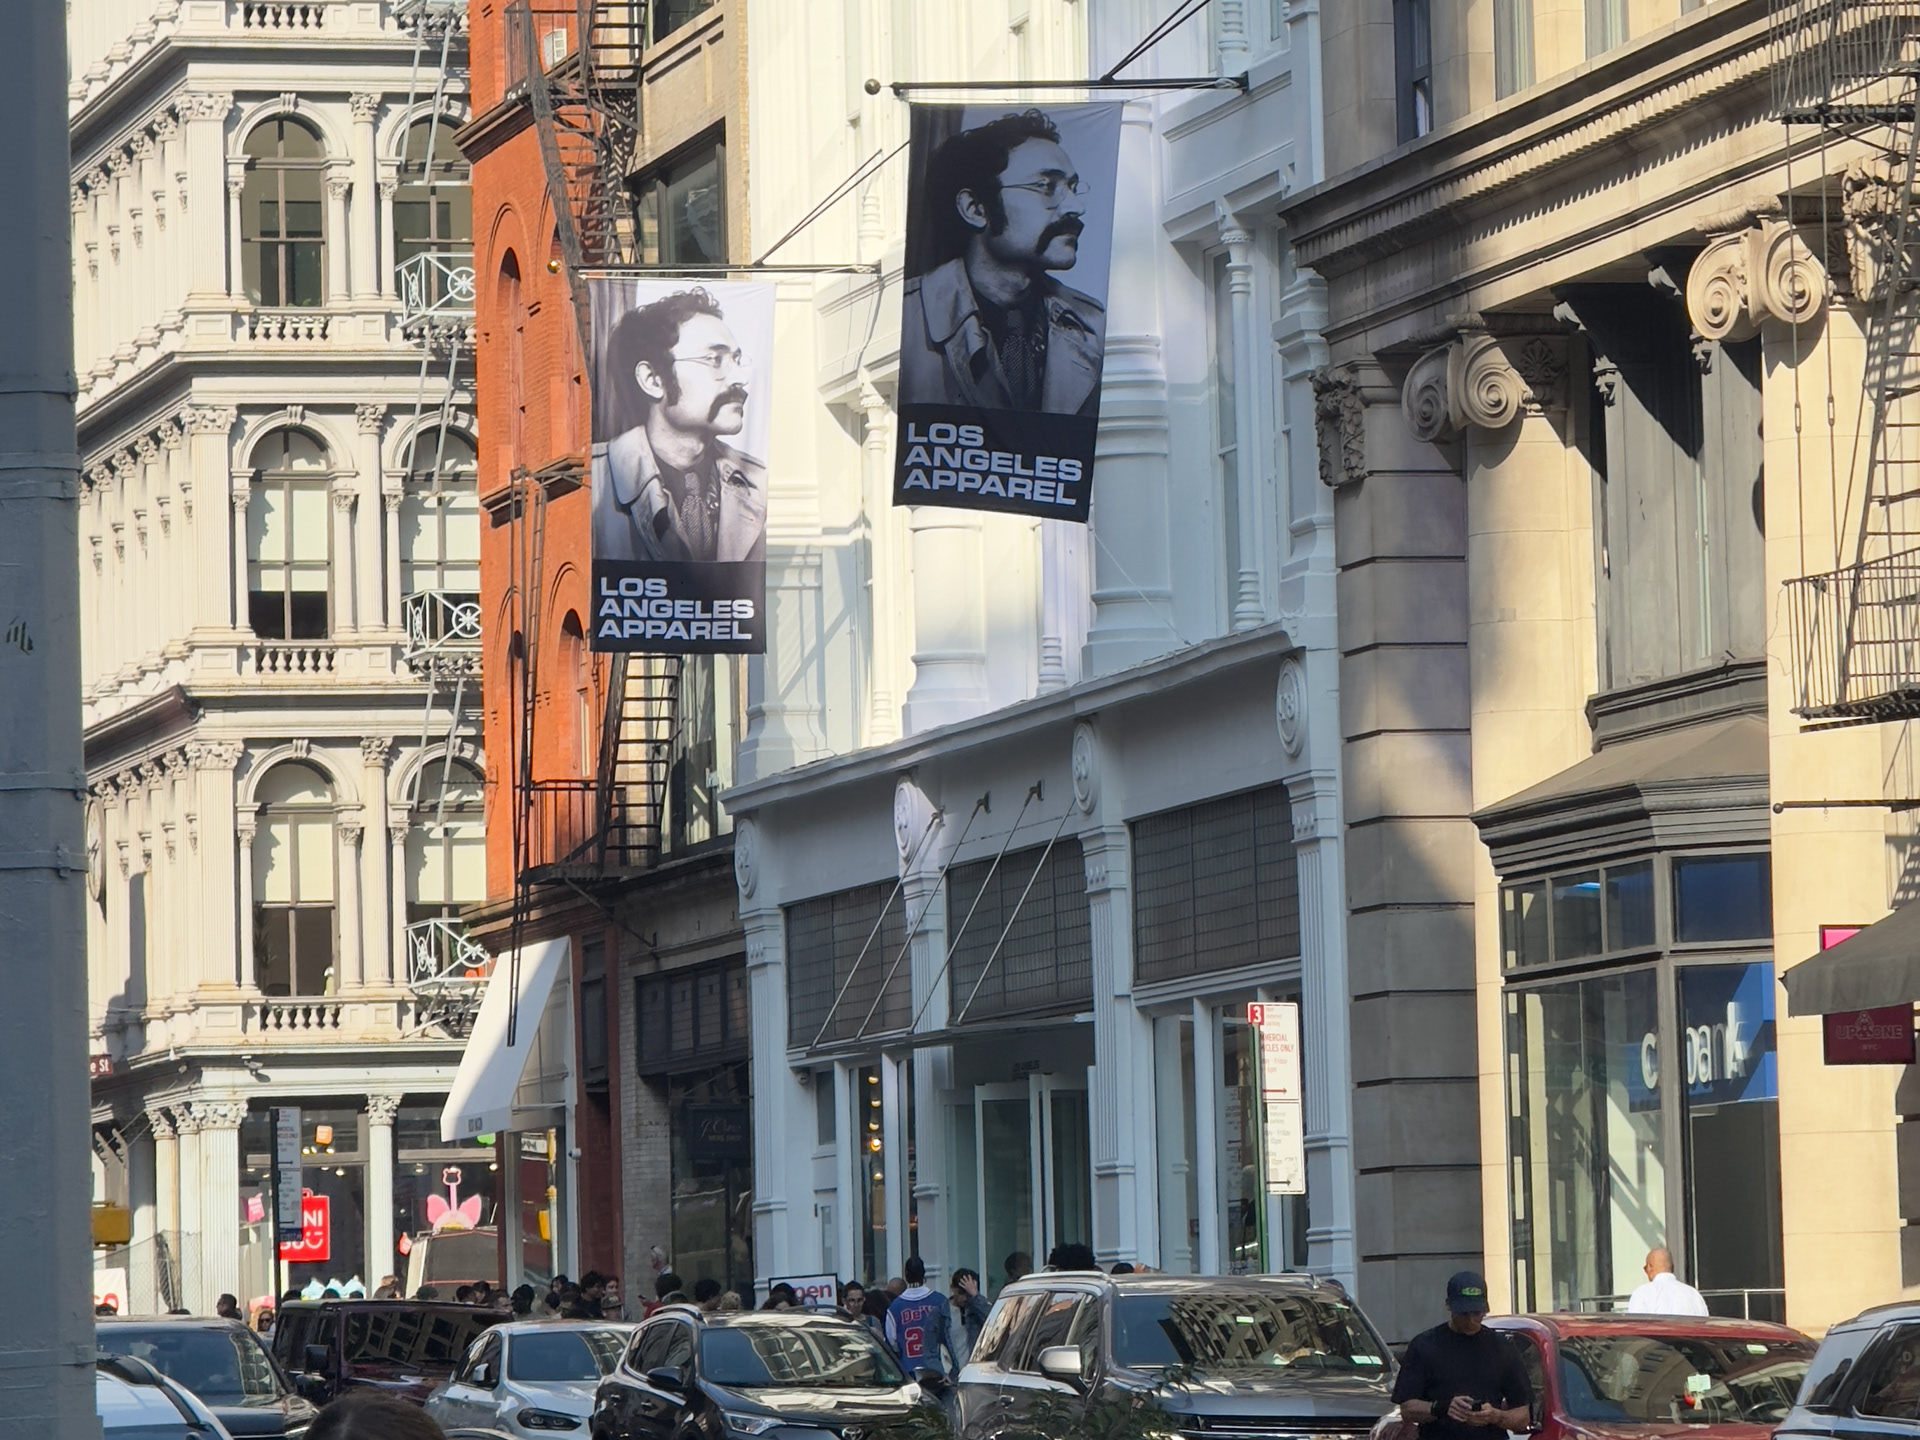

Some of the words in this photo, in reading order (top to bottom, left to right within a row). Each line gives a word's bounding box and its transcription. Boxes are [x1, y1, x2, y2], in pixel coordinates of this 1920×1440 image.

[907, 422, 984, 447] LOS
[904, 445, 1083, 482] ANGELES
[903, 469, 1077, 506] APPAREL
[601, 577, 668, 597] LOS
[599, 598, 755, 619] ANGELES
[598, 619, 752, 640] APPAREL
[1252, 1005, 1262, 1023] 3
[1641, 1001, 1747, 1090] cbank
[98, 1058, 110, 1073] St
[303, 1210, 323, 1228] NI
[793, 1283, 832, 1302] pen
